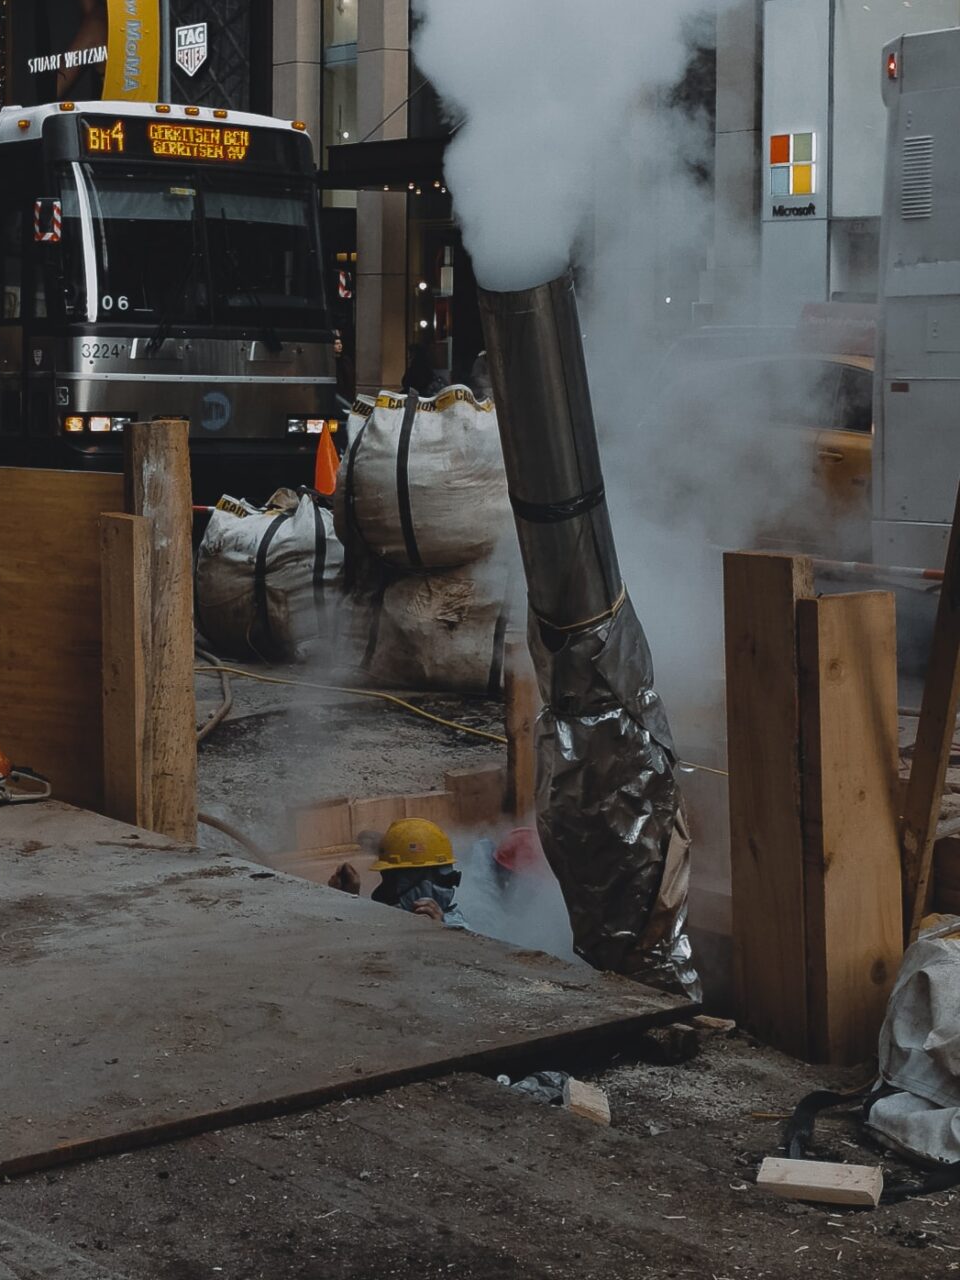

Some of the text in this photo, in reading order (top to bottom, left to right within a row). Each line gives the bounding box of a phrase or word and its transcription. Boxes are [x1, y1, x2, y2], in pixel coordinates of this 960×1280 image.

[178, 27, 205, 46] TAG
[27, 45, 108, 73] STUART WEITZMA
[122, 20, 143, 92] MoMA
[176, 47, 205, 71] HEUER
[149, 125, 249, 146] GERRITSEN BCH
[153, 141, 223, 158] GERRITSEN
[772, 202, 816, 218] Microsoft
[81, 343, 120, 359] 3224
